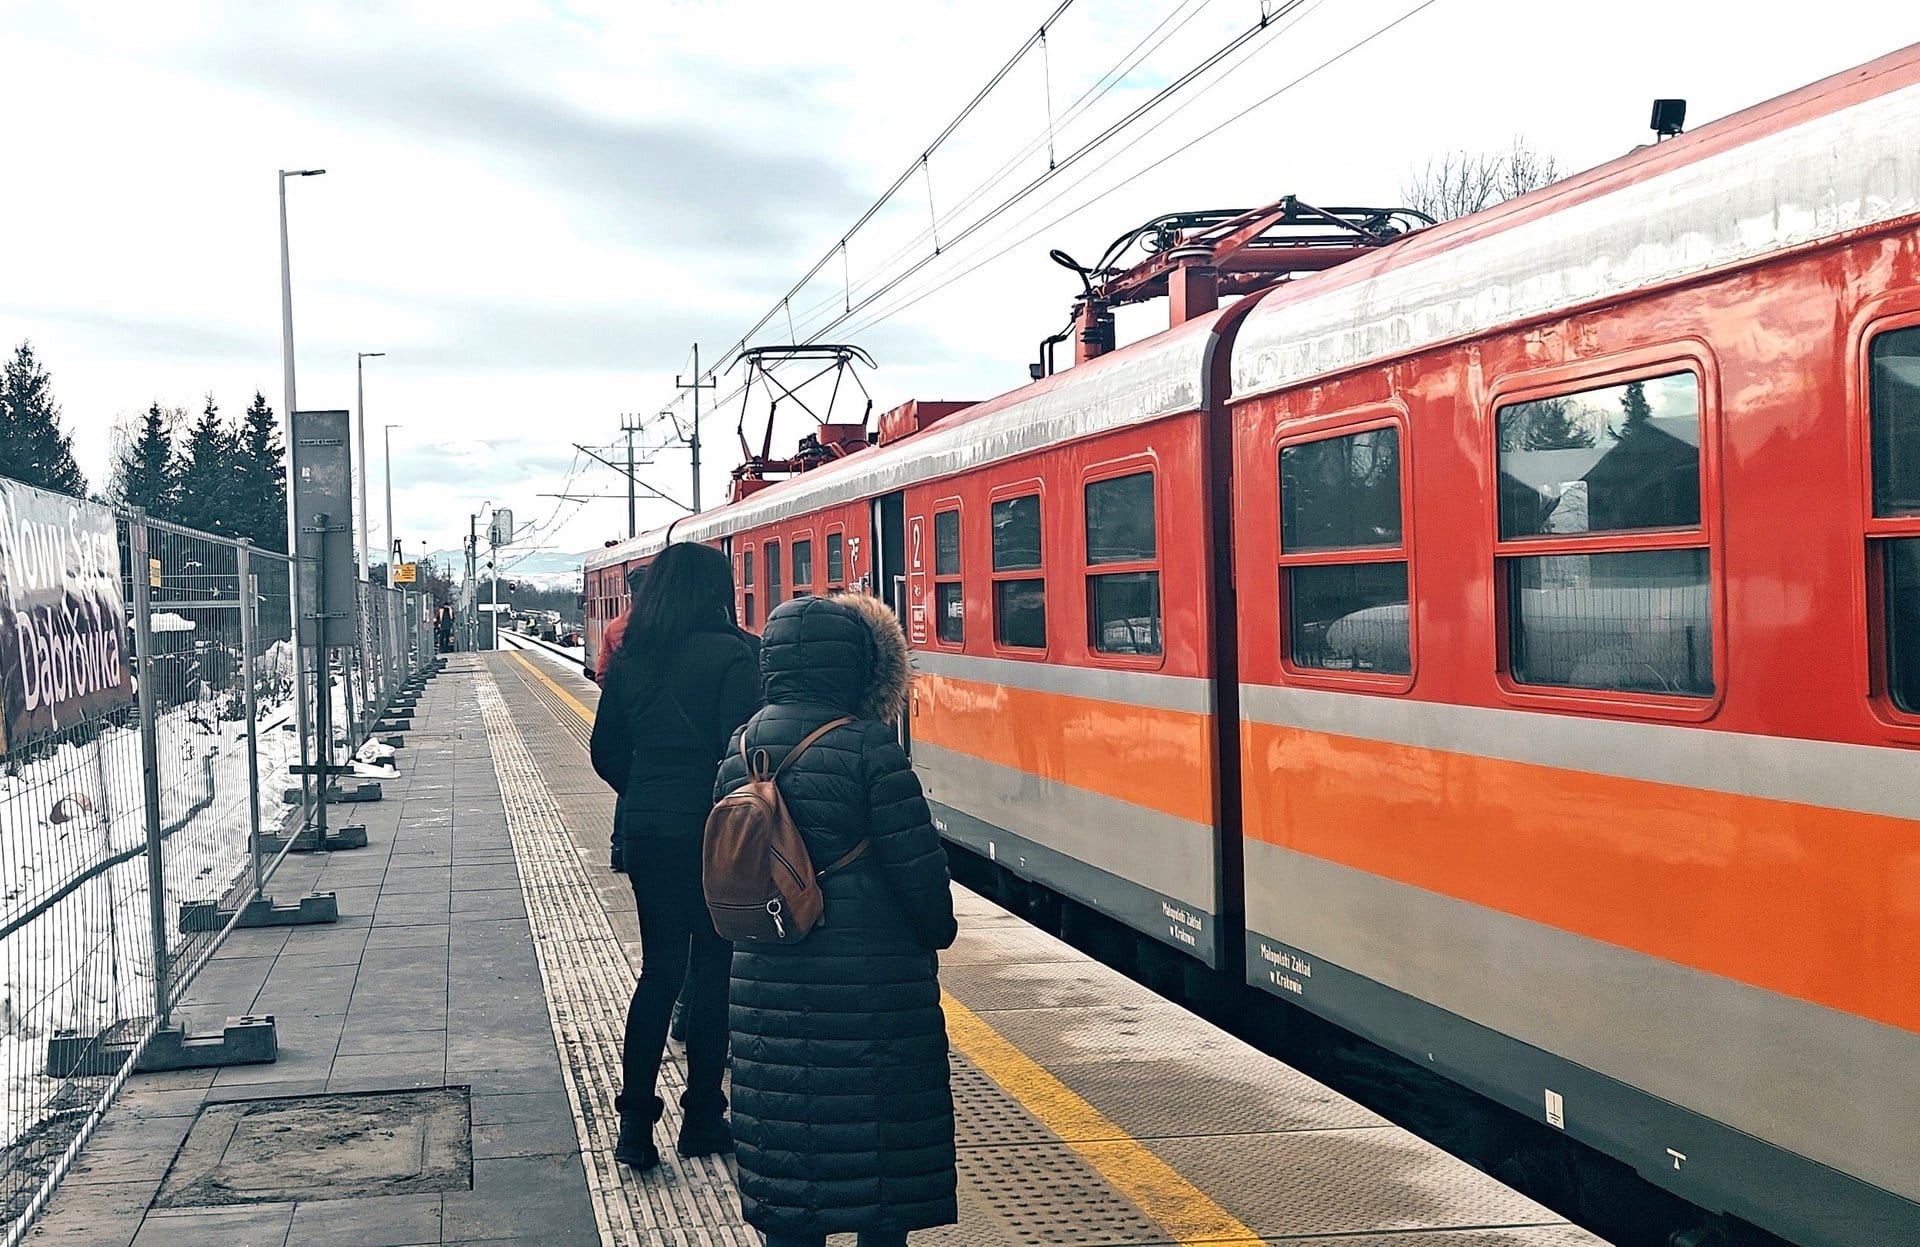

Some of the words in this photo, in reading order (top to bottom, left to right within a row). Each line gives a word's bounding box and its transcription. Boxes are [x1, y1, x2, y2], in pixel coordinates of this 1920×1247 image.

[0, 491, 67, 606] Nowy
[913, 523, 921, 568] 2
[16, 607, 121, 731] Dąbrówka
[1276, 971, 1302, 995] Krakowie
